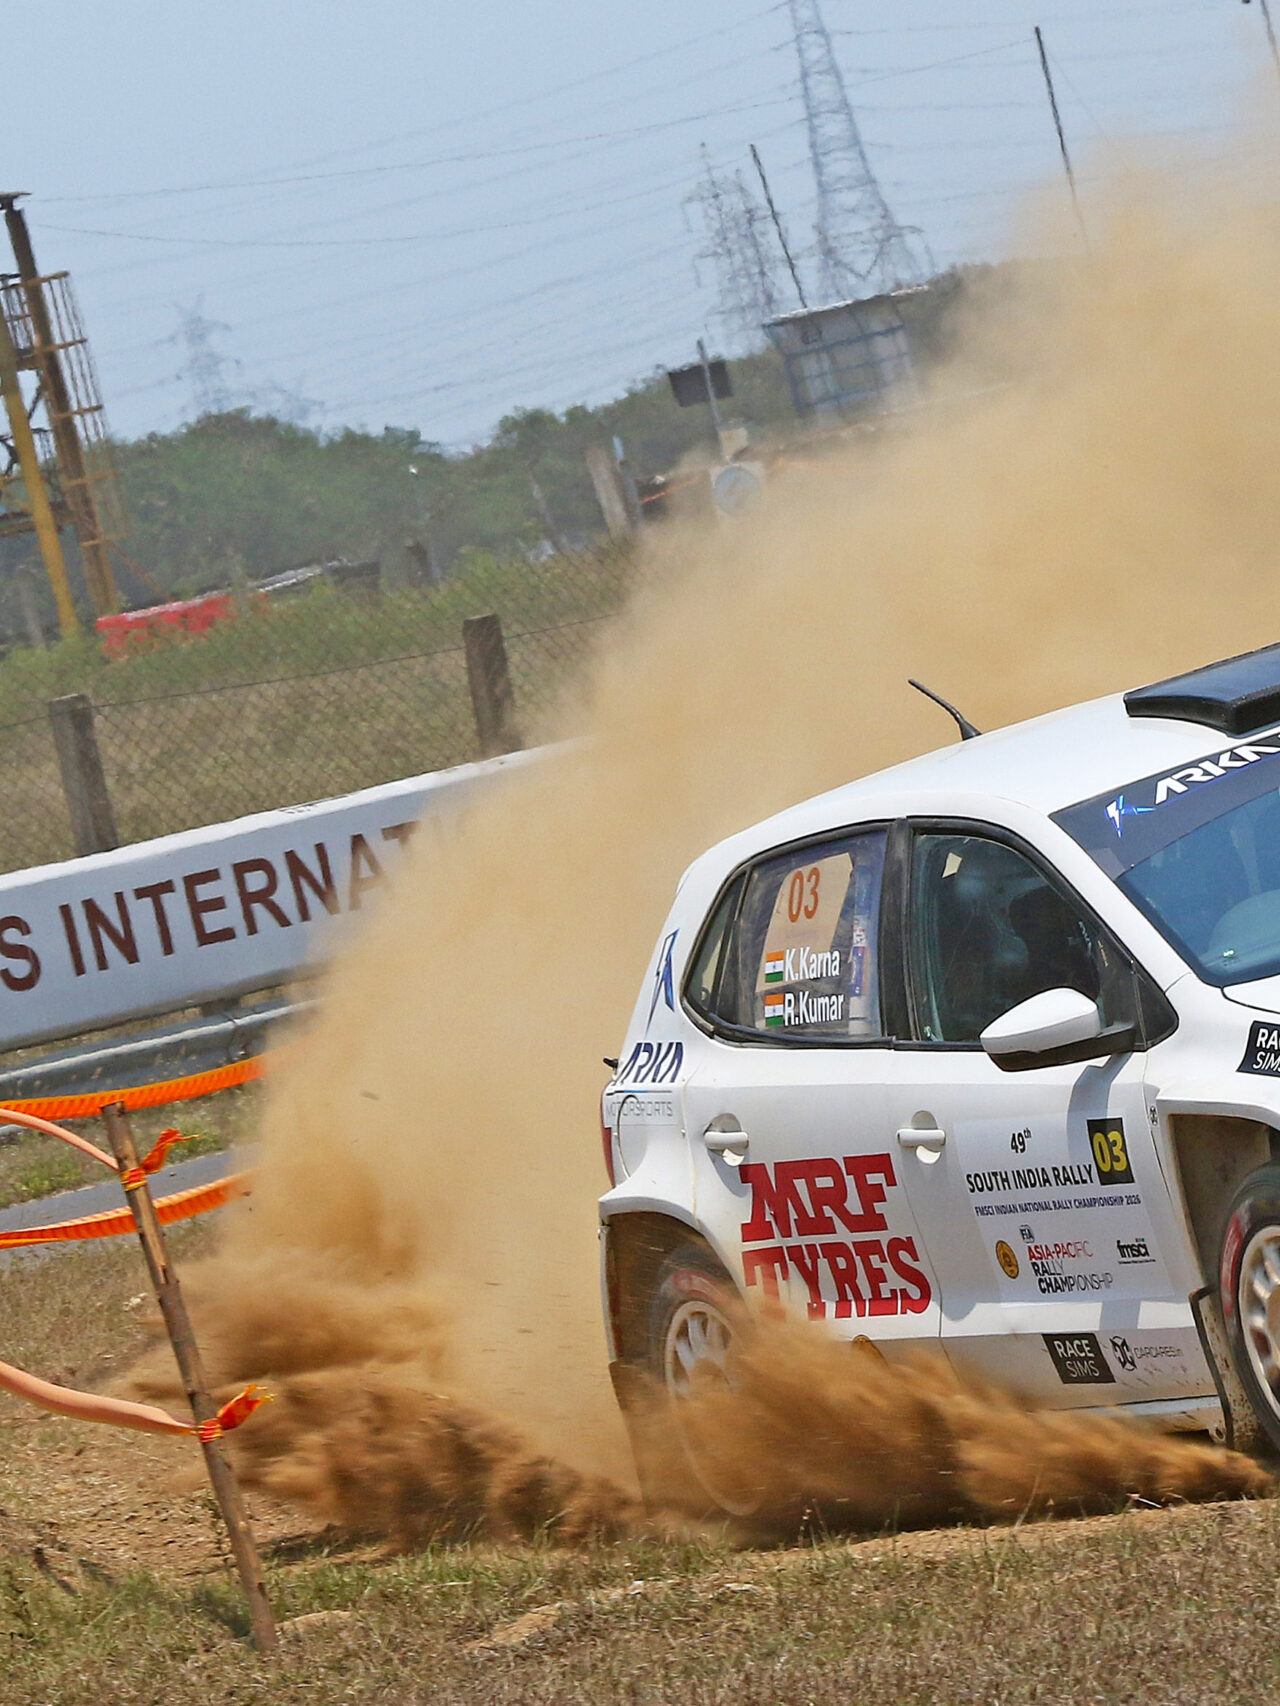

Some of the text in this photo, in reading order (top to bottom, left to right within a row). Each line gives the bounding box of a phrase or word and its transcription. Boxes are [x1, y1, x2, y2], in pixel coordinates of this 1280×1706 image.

[788, 866, 820, 923] 03
[784, 946, 840, 982] K.Karna
[784, 990, 844, 1026] R.Kumar
[1010, 1127, 1032, 1154] 49th
[1092, 1130, 1128, 1173] 03
[966, 1164, 1095, 1193] SOUTH INDIA RALLY
[738, 1153, 897, 1243] MRF
[974, 1204, 995, 1217] FMSCI
[994, 1202, 1018, 1215] INDIAN
[1019, 1200, 1053, 1213] NATIONAL
[1053, 1199, 1074, 1211] RALLY
[1074, 1195, 1124, 1210] CHAMPIONSHIP
[1027, 1240, 1094, 1262] ASIA-PACIFIC
[1116, 1238, 1150, 1259] fmsci
[741, 1235, 932, 1322] TYRES
[1031, 1260, 1065, 1277] RALLY
[1038, 1272, 1114, 1294] CHAMPIONSHIP
[1054, 1339, 1095, 1359] RACE
[1065, 1360, 1100, 1378] SIMS
